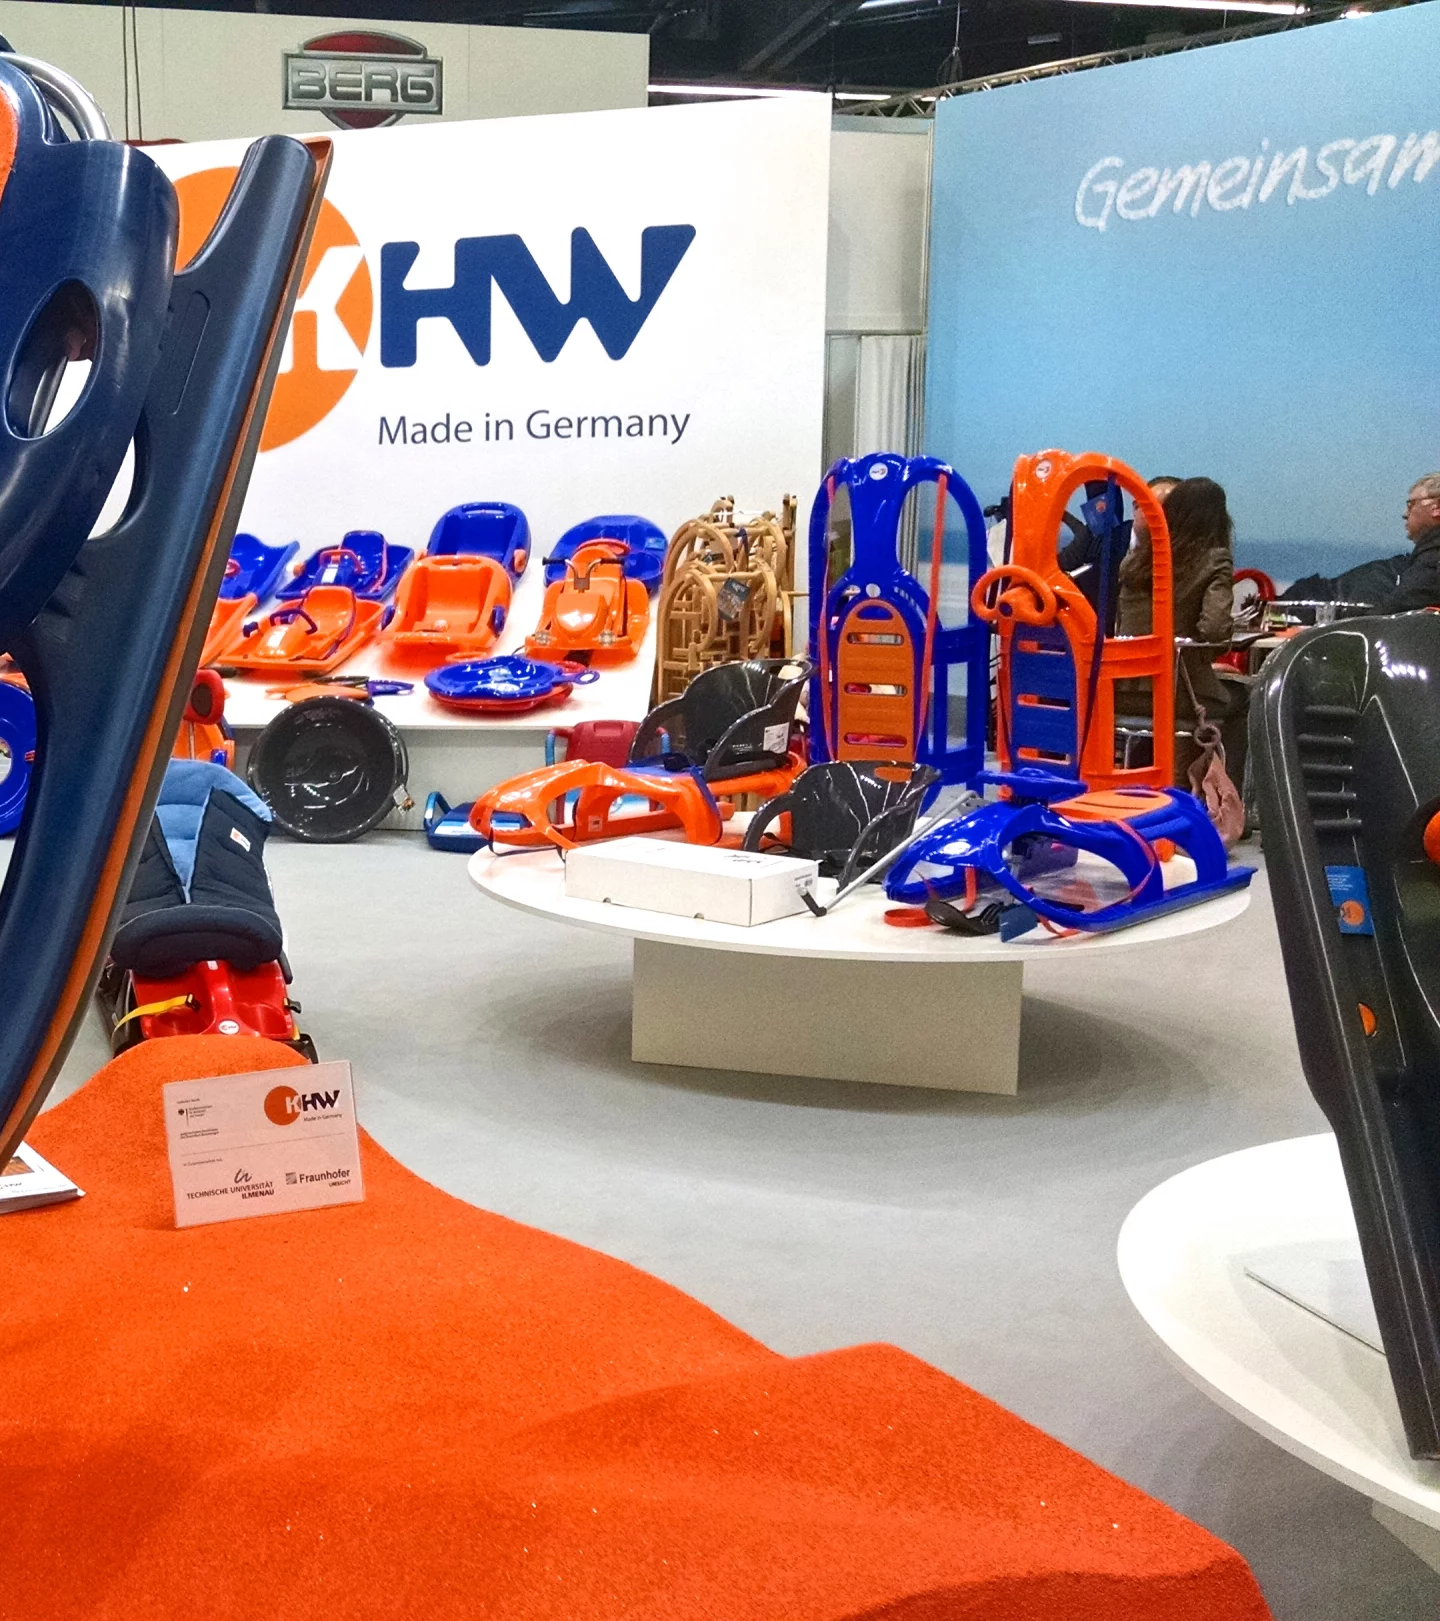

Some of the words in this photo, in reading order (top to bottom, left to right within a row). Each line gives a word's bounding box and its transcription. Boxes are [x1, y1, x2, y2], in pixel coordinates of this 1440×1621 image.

[291, 61, 435, 104] BERG
[378, 412, 472, 445] Made
[484, 412, 514, 441] in
[526, 409, 691, 445] Germany
[285, 1089, 340, 1114] KHW
[299, 1168, 351, 1184] Fraunhofer
[187, 1187, 229, 1200] TECHNISCHE
[230, 1181, 274, 1194] UNIVERSITÄT
[242, 1189, 275, 1200] ILMENAU
